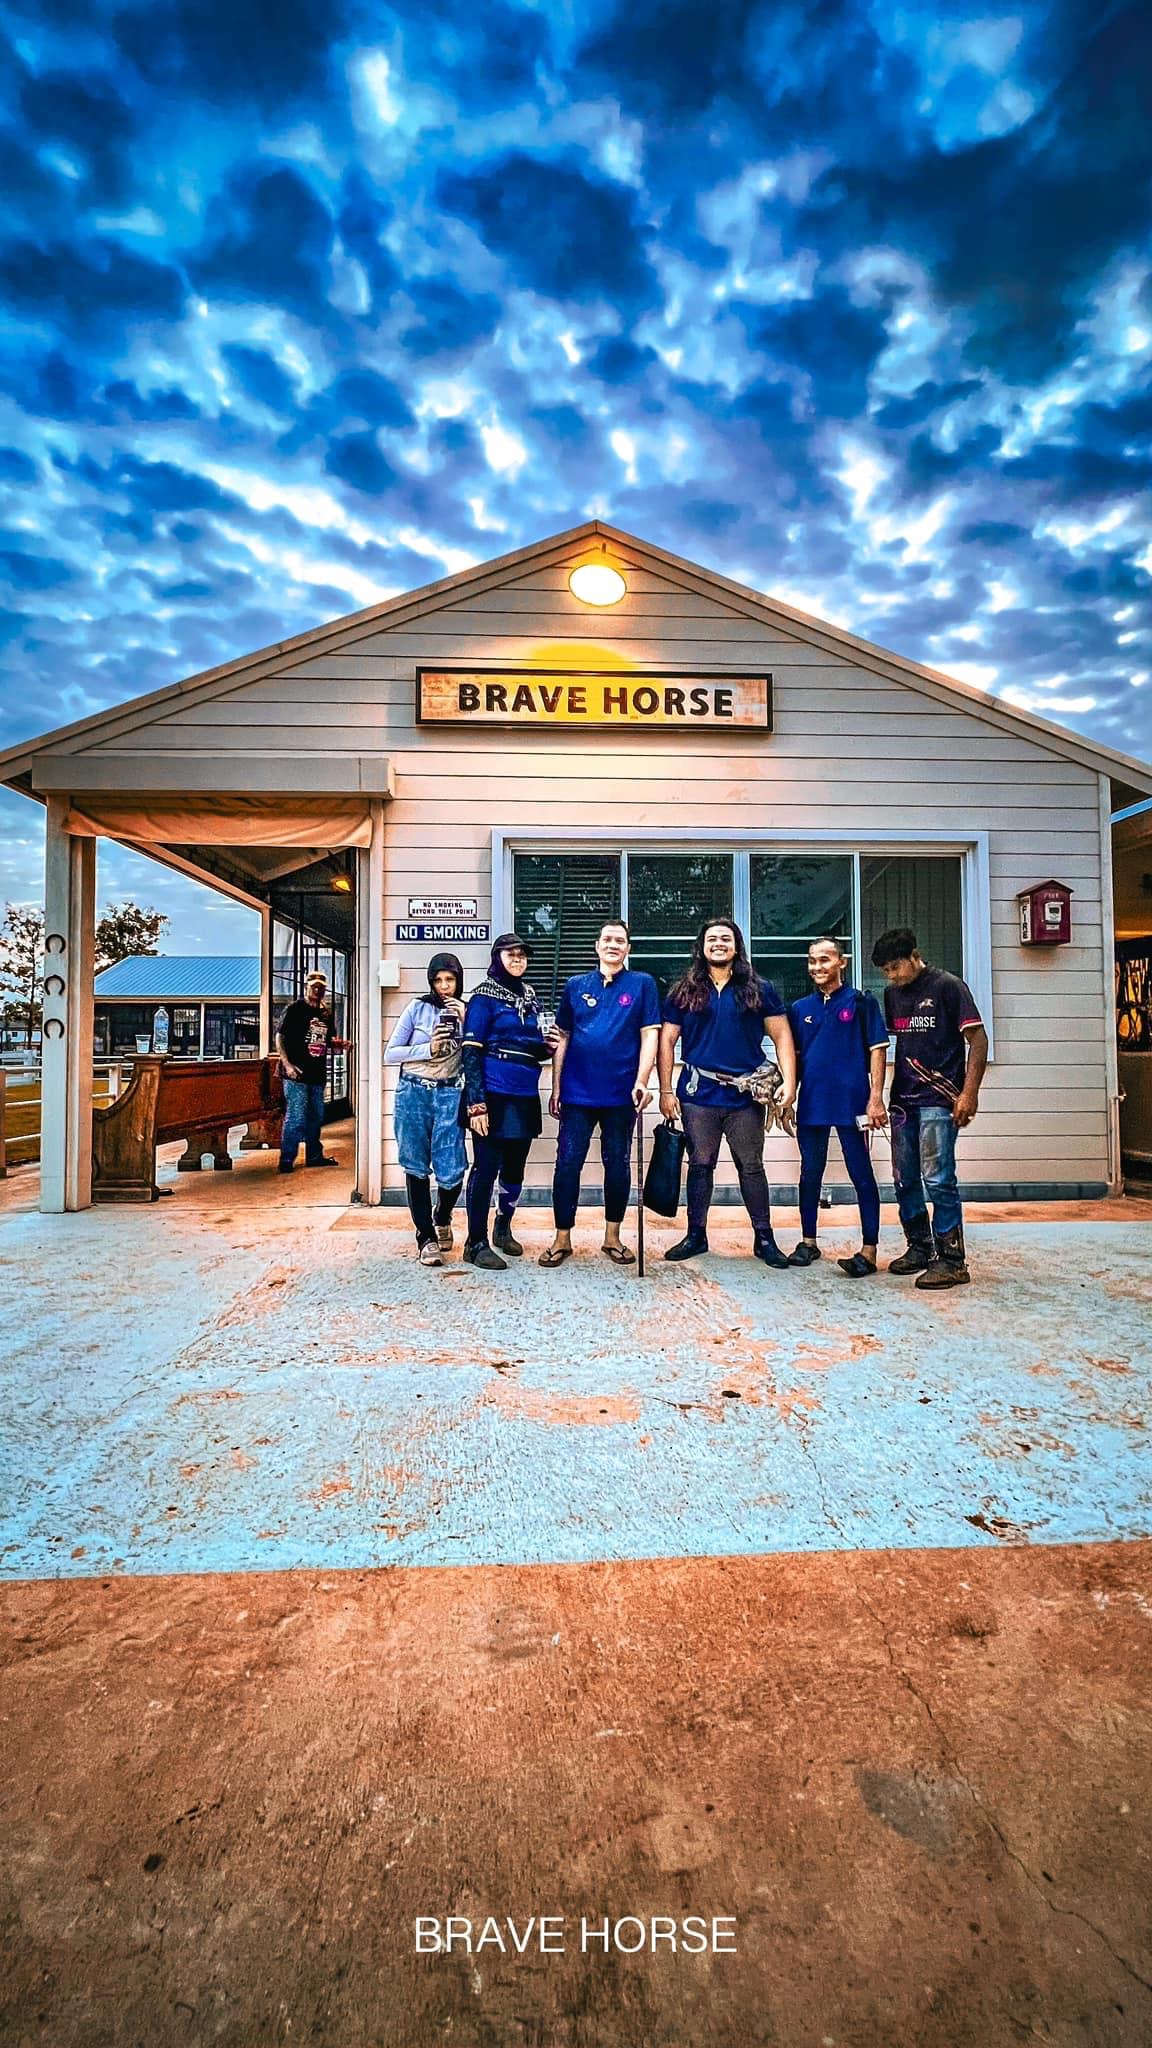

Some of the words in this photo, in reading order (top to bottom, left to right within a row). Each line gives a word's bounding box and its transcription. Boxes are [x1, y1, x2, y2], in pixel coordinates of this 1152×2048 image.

[458, 683, 587, 713] BRAVE
[603, 686, 733, 717] HORSE
[399, 925, 418, 939] NO
[423, 925, 487, 939] SMOKING
